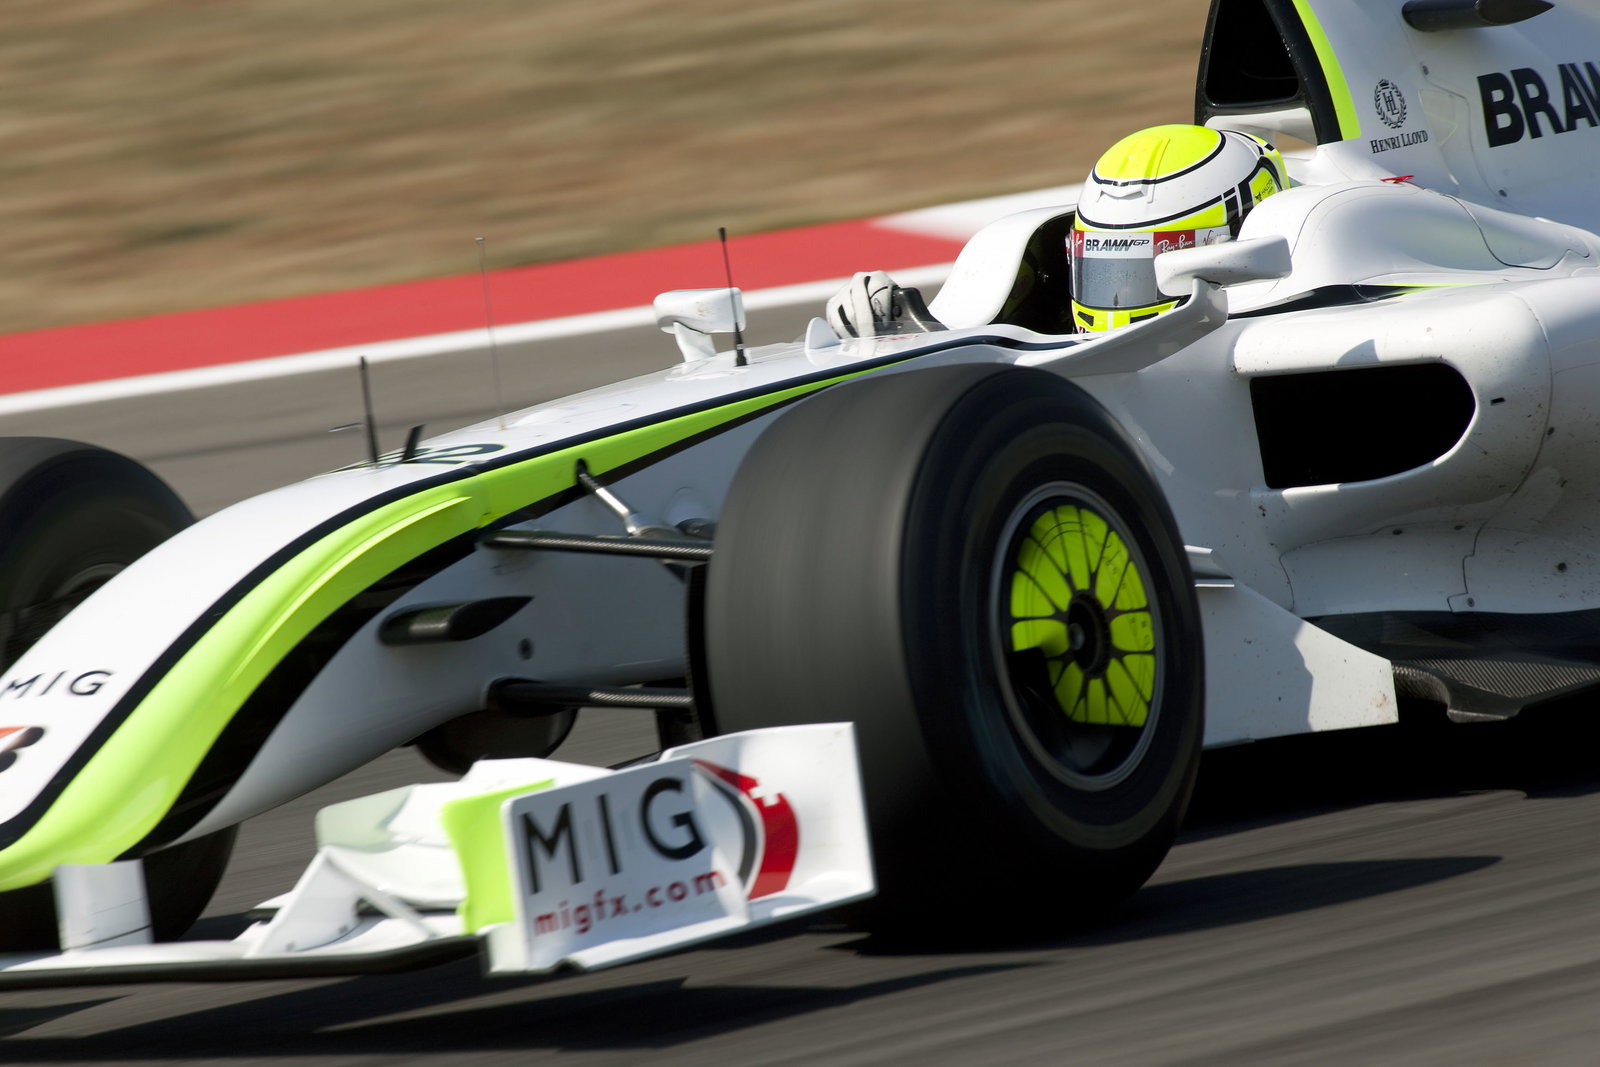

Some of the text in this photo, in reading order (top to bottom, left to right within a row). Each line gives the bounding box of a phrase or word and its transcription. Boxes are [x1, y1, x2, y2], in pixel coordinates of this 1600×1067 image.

[1370, 130, 1429, 154] HENRI LLOYD
[0, 670, 114, 699] MIG
[521, 777, 706, 896] MIG
[533, 871, 727, 937] migfx.com
